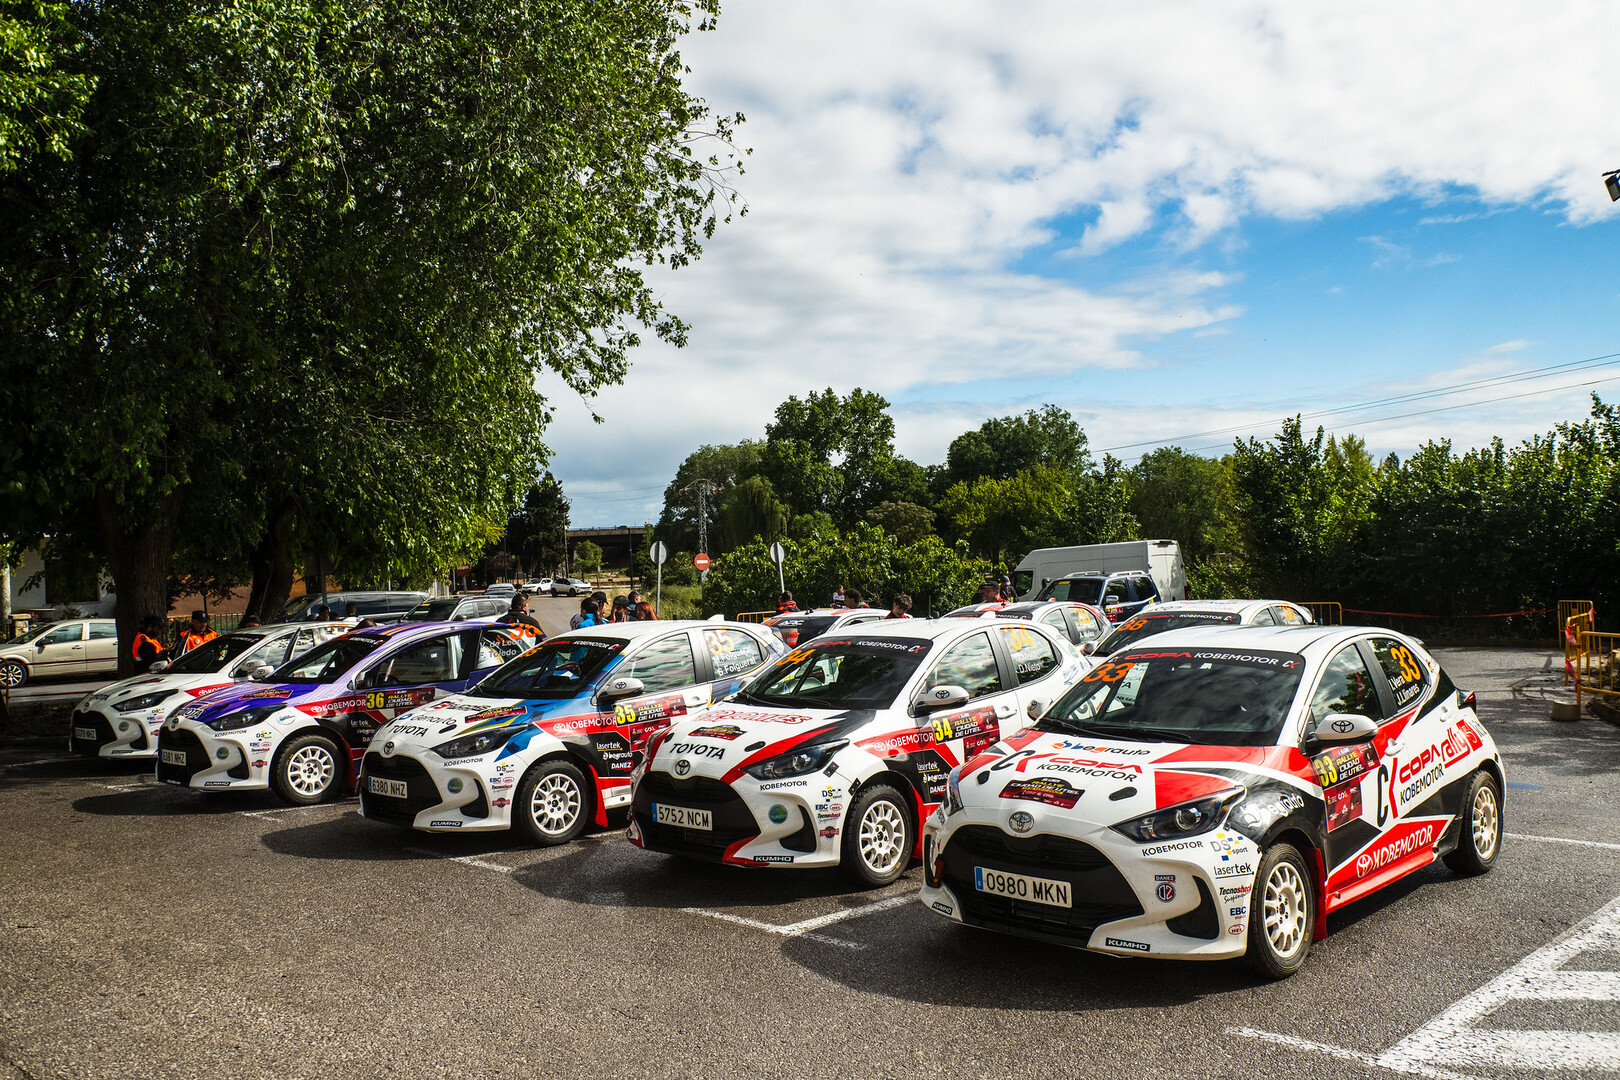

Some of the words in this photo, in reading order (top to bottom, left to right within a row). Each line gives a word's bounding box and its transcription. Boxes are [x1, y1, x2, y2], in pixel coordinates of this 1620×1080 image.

[1118, 619, 1148, 632] 38
[703, 630, 735, 656] 35
[1003, 624, 1034, 651] 34
[856, 641, 908, 651] KOBEMOTOR
[489, 649, 517, 658] Toledo
[775, 649, 817, 666] 34
[1124, 652, 1192, 661] COPA
[1194, 652, 1279, 666] KOBEMOTOR
[1018, 662, 1041, 674] D.Nieto
[1390, 645, 1421, 683] 33
[1082, 662, 1135, 682] 33
[366, 692, 385, 709] 36
[614, 703, 636, 725] 35
[638, 703, 662, 712] RALLYE
[639, 708, 664, 716] CIUDAD
[648, 712, 668, 721] UTIEL
[566, 716, 617, 730] KOBEMOTOR
[954, 716, 977, 727] RALLYE
[214, 729, 247, 738] KOBEMOTOR
[389, 725, 428, 738] TOYOTA
[932, 717, 953, 742] 34
[956, 721, 978, 732] CIUDAD
[964, 727, 982, 736] UTIEL
[596, 741, 621, 750] lasertek
[885, 732, 935, 749] KOBEMOTOR
[669, 743, 726, 760] TOYOTA
[1070, 743, 1151, 756] begrauto
[174, 752, 185, 765] NHZ
[443, 757, 484, 768] KOBEMOTOR
[1336, 750, 1358, 766] RALLYE
[1400, 744, 1440, 784] COPA
[611, 762, 632, 770] DANEZ
[917, 761, 938, 772] lasertek
[1049, 757, 1143, 774] COPA
[1314, 755, 1338, 787] 33
[1339, 757, 1361, 773] CIUDAD
[1340, 772, 1348, 780] DE
[1348, 764, 1365, 776] UTIEL
[1036, 763, 1138, 783] KOBEMOTOR
[372, 779, 389, 794] 6380
[391, 782, 406, 797] NHZ
[760, 780, 808, 791] KOBEMOTOR
[1400, 763, 1445, 806] KOBEMOTOR
[821, 789, 833, 798] DS
[658, 806, 684, 824] 5752
[687, 810, 711, 829] NCM
[1142, 840, 1204, 857] KOBEMOTOR
[1210, 839, 1232, 853] DS
[1232, 846, 1249, 855] sport
[1373, 824, 1433, 870] KOBEMOTOR
[1213, 862, 1252, 876] lasertek
[986, 872, 1027, 897] 0980
[1033, 881, 1068, 905] MKN
[1230, 906, 1247, 916] EBC
[1107, 938, 1149, 951] KUMHO
